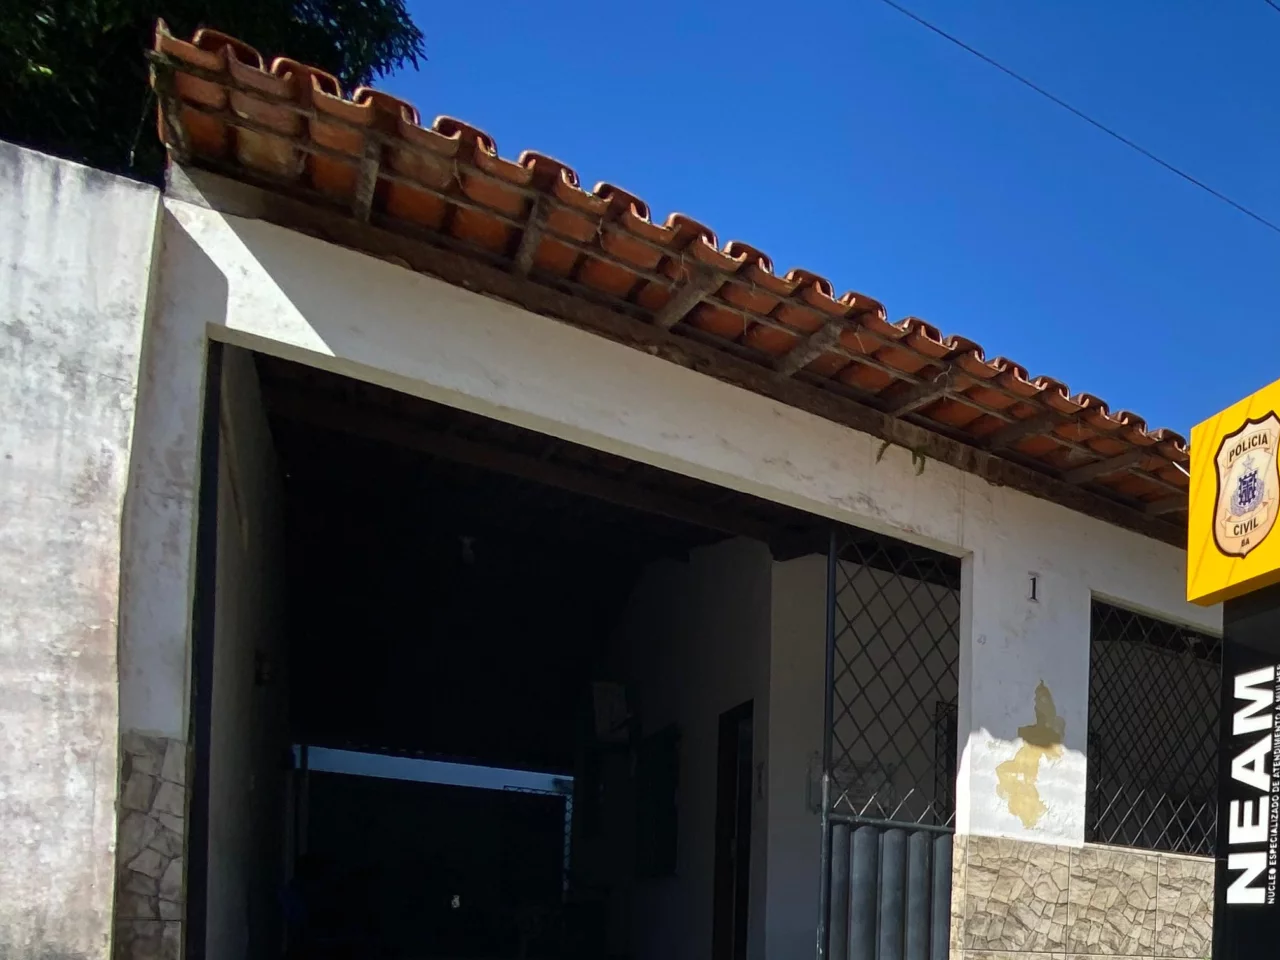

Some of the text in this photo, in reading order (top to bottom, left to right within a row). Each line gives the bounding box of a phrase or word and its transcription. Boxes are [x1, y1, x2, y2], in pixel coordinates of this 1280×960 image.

[1233, 517, 1259, 536] CIVIL
[1226, 665, 1275, 904] NEAM
[1272, 780, 1280, 793] DE
[1268, 795, 1280, 866] ESPECIALIZADO
[1267, 868, 1277, 905] NUCLEO
